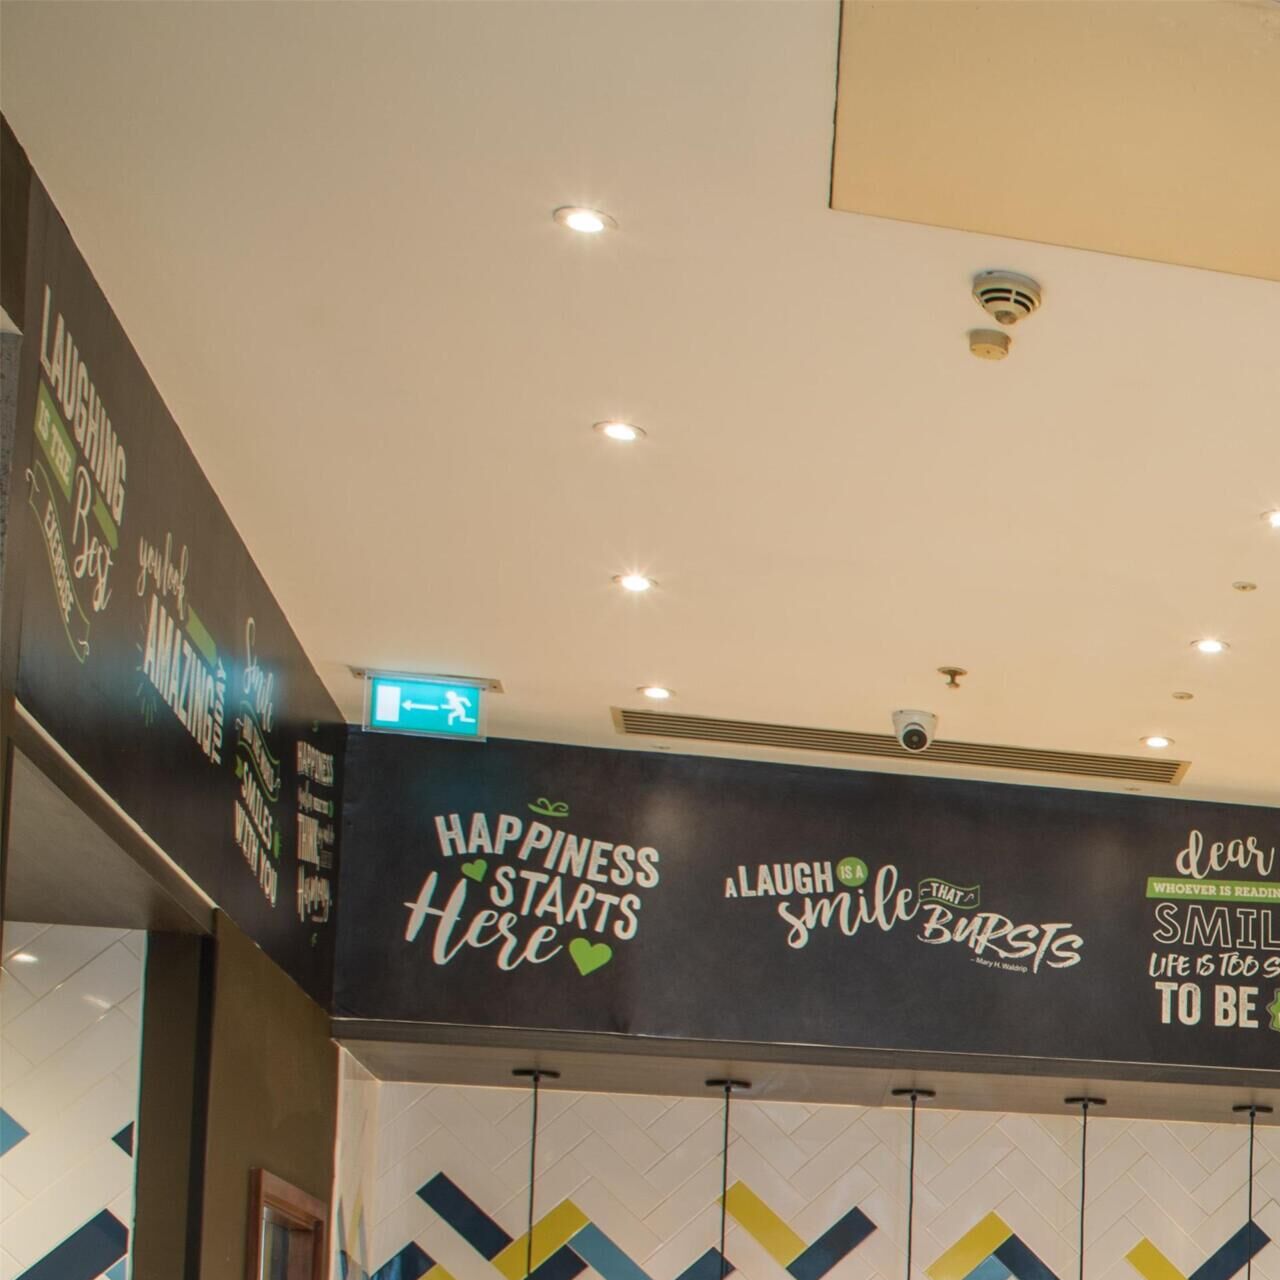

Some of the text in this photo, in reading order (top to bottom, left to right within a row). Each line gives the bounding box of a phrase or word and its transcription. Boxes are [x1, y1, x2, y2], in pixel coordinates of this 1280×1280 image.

[37, 401, 72, 483] IS THE
[40, 284, 127, 526] LAUGHING
[43, 500, 74, 624] EXERCISE
[73, 465, 114, 612] Best
[143, 593, 215, 762] AMAZING
[211, 657, 228, 766] TODAY
[241, 761, 273, 850] SMILES
[434, 812, 660, 888] HAPPINESS
[725, 861, 865, 898] A LAUGH IS A
[1153, 882, 1217, 896] WHOEVER
[1219, 886, 1232, 896] IS
[1176, 829, 1275, 879] dear
[403, 871, 563, 971] Here
[490, 865, 641, 940] STARTS
[778, 865, 920, 949] smile
[929, 882, 965, 905] THAT
[1149, 952, 1190, 977] LIFE
[1196, 954, 1215, 976] IS
[1219, 952, 1259, 977] TOO
[1155, 981, 1259, 1029] TO BE
